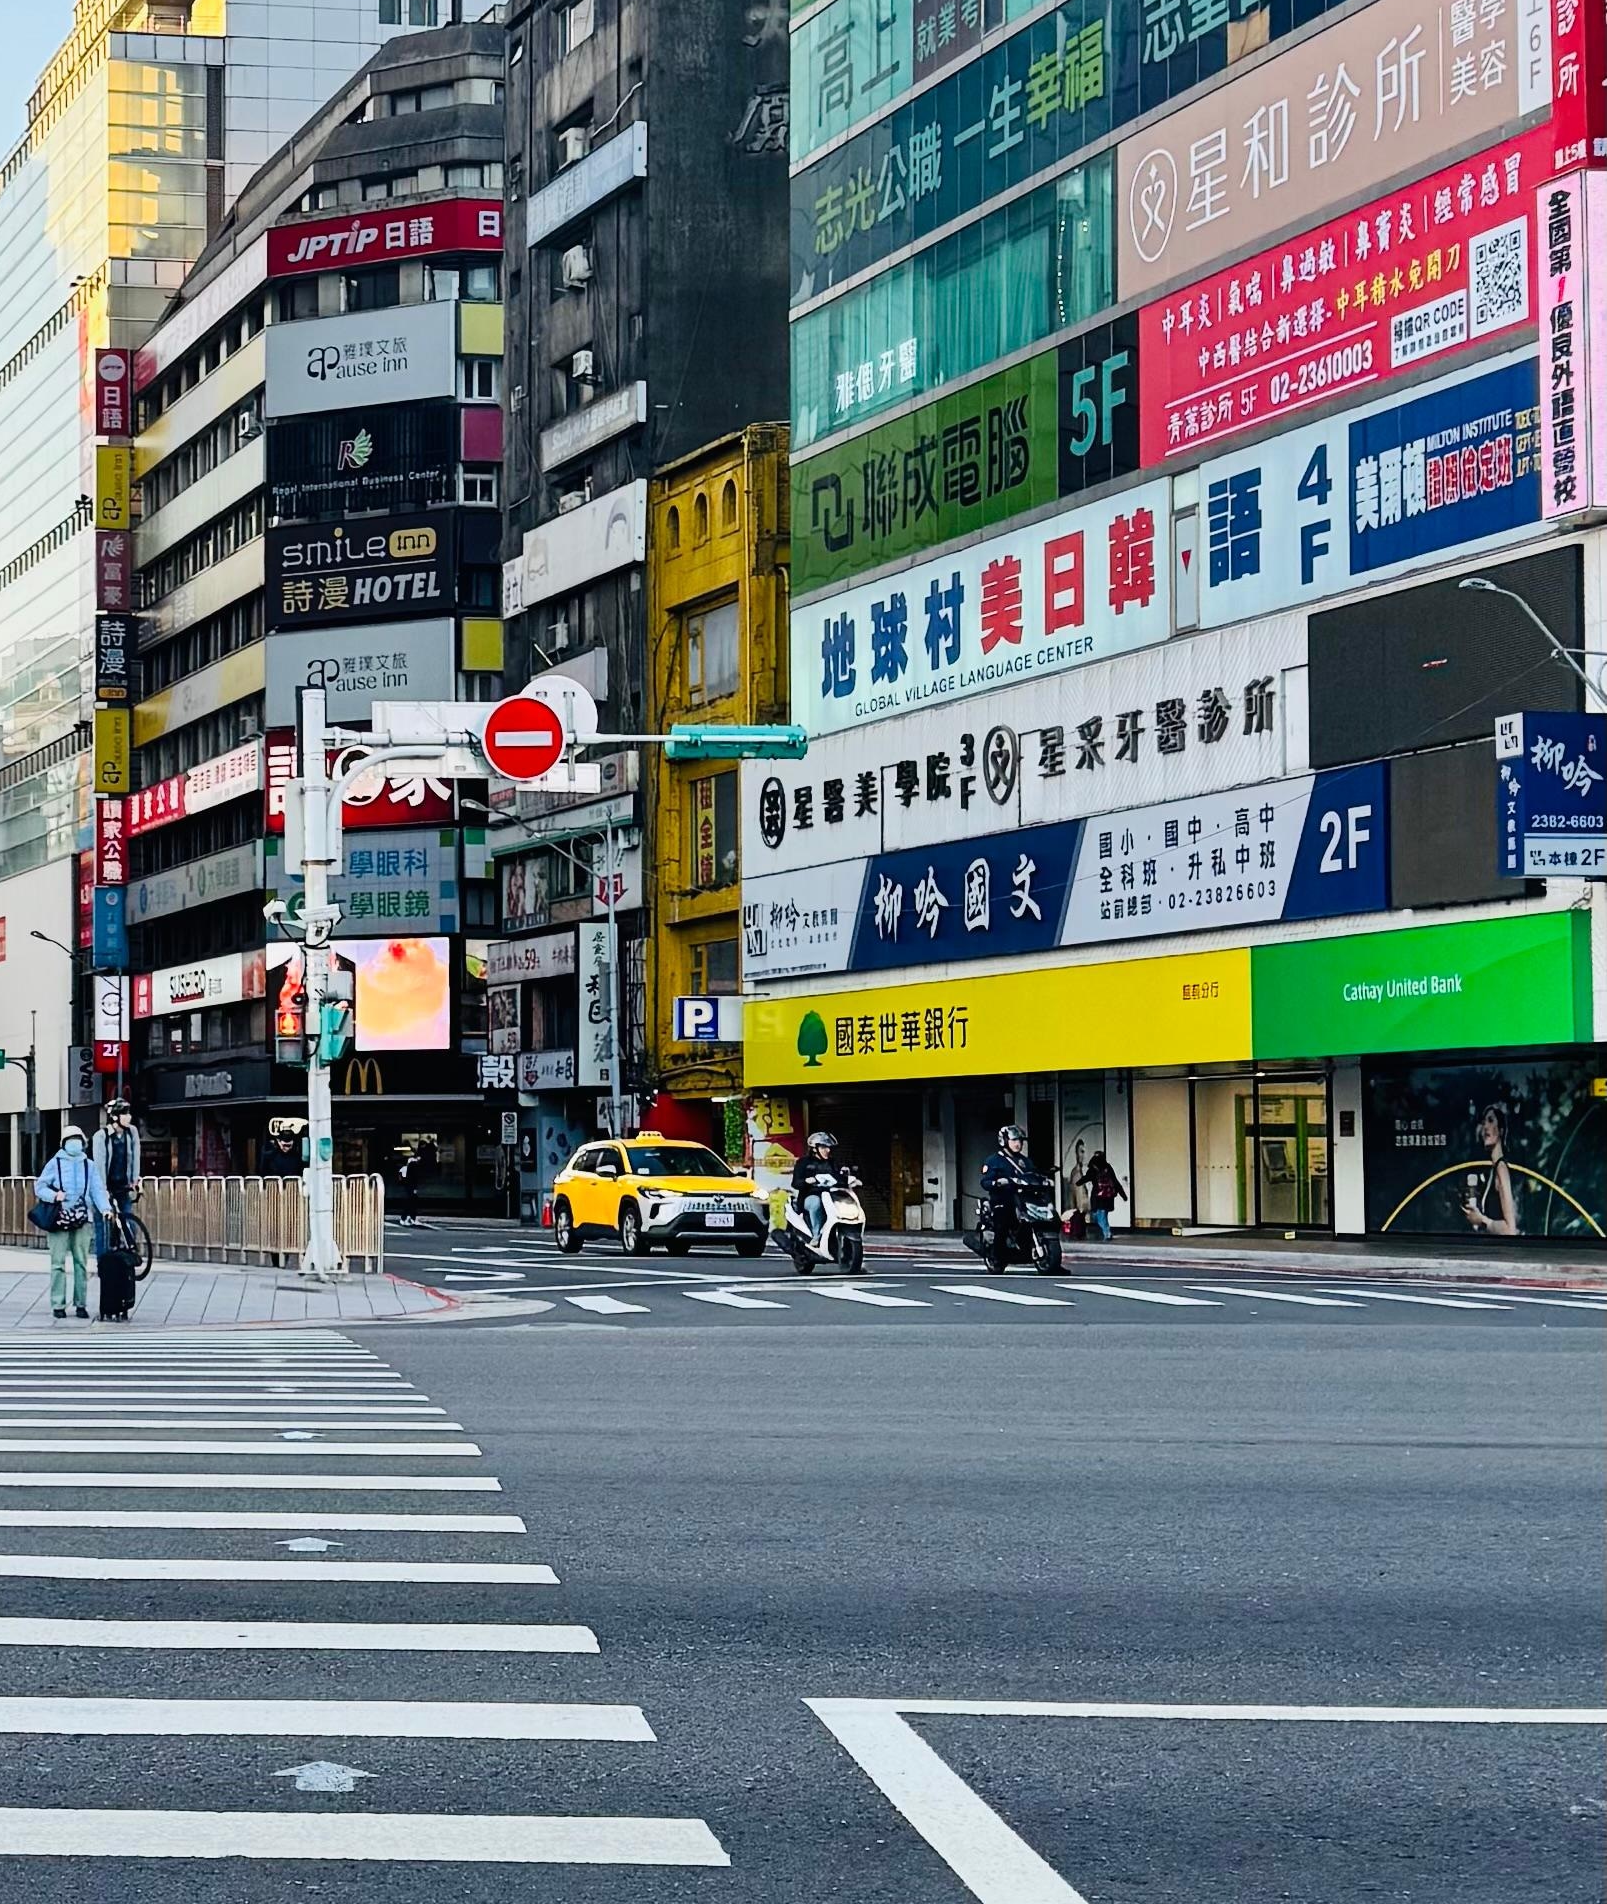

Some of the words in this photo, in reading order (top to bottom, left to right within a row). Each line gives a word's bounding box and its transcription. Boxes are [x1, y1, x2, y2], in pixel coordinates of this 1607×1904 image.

[1449, 39, 1508, 107] 美容
[813, 119, 943, 257] 志光公職
[951, 17, 1106, 160] 一生幸福
[1183, 22, 1429, 234] 星和診所
[384, 215, 435, 251] 日語
[1069, 349, 1130, 458] 5F
[1240, 383, 1260, 417] 5F
[1269, 338, 1375, 406] 02-23610003
[1462, 408, 1513, 441] INSTITUTE
[301, 477, 359, 494] International
[362, 473, 405, 487] Business
[408, 468, 441, 482] Center
[861, 394, 1031, 544] 聯成電腦
[1207, 466, 1264, 590] 語
[281, 575, 351, 615] 詩漫
[352, 570, 442, 606] HOTEL
[99, 619, 127, 676] 詩漫
[854, 686, 901, 718] GLOBAL
[903, 673, 956, 706] VILLAGE
[959, 652, 1034, 689] LANGUAGE
[1036, 635, 1095, 671] CENTER
[1036, 675, 1277, 778] 星采牙醫診所
[1529, 734, 1605, 798] 柳吟
[1319, 803, 1373, 875] 2F
[1530, 814, 1605, 829] 2382-6603
[343, 848, 430, 880] 學眼科
[1168, 879, 1276, 910] 02-23826603
[873, 853, 1044, 943] 柳吟國文
[683, 999, 714, 1038] P
[1343, 979, 1384, 1005] Cathay
[1386, 976, 1428, 1000] United
[1430, 973, 1464, 996] Bank
[834, 1005, 970, 1058] 國泰世華銀行
